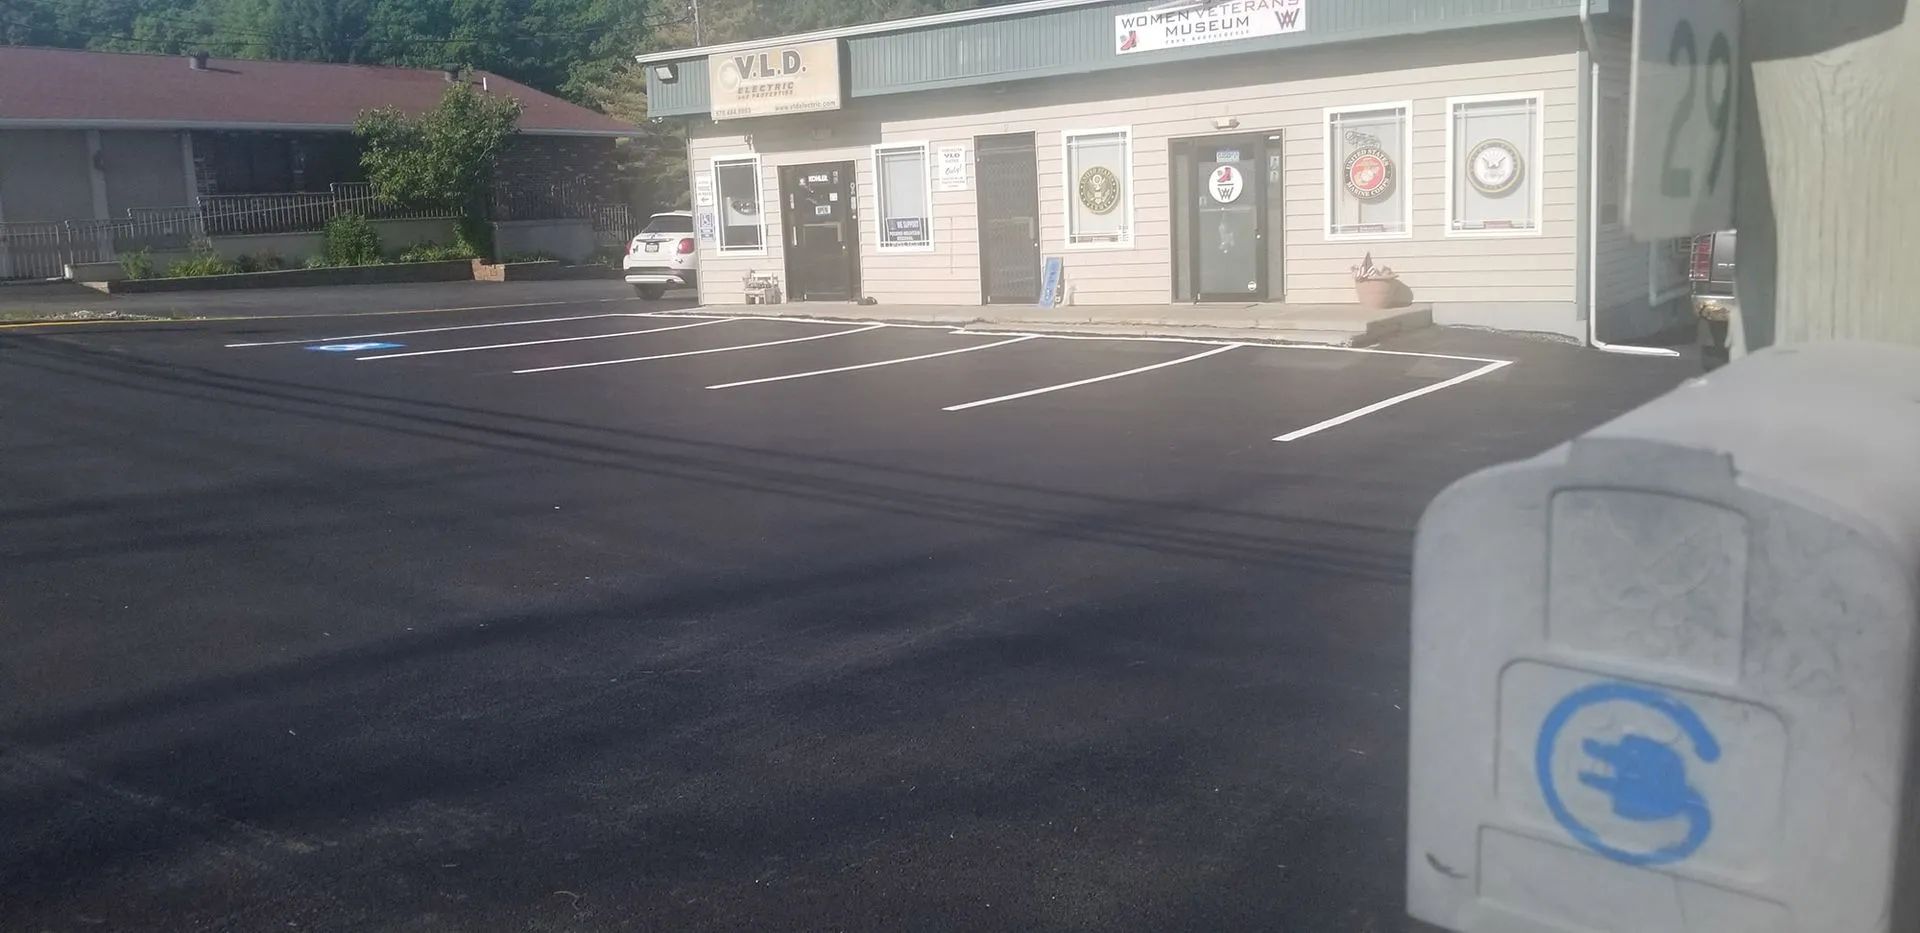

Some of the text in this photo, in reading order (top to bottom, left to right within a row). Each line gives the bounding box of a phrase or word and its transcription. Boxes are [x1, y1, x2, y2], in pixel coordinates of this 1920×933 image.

[1121, 0, 1298, 29] WOMEN VETERANS
[1166, 16, 1249, 37] MUSEUM
[734, 51, 806, 79] V.L.D.
[738, 82, 794, 94] ELECTRIC
[1661, 19, 1731, 198] 29
[1346, 150, 1366, 169] UNITED
[1346, 181, 1370, 197] MARINE
